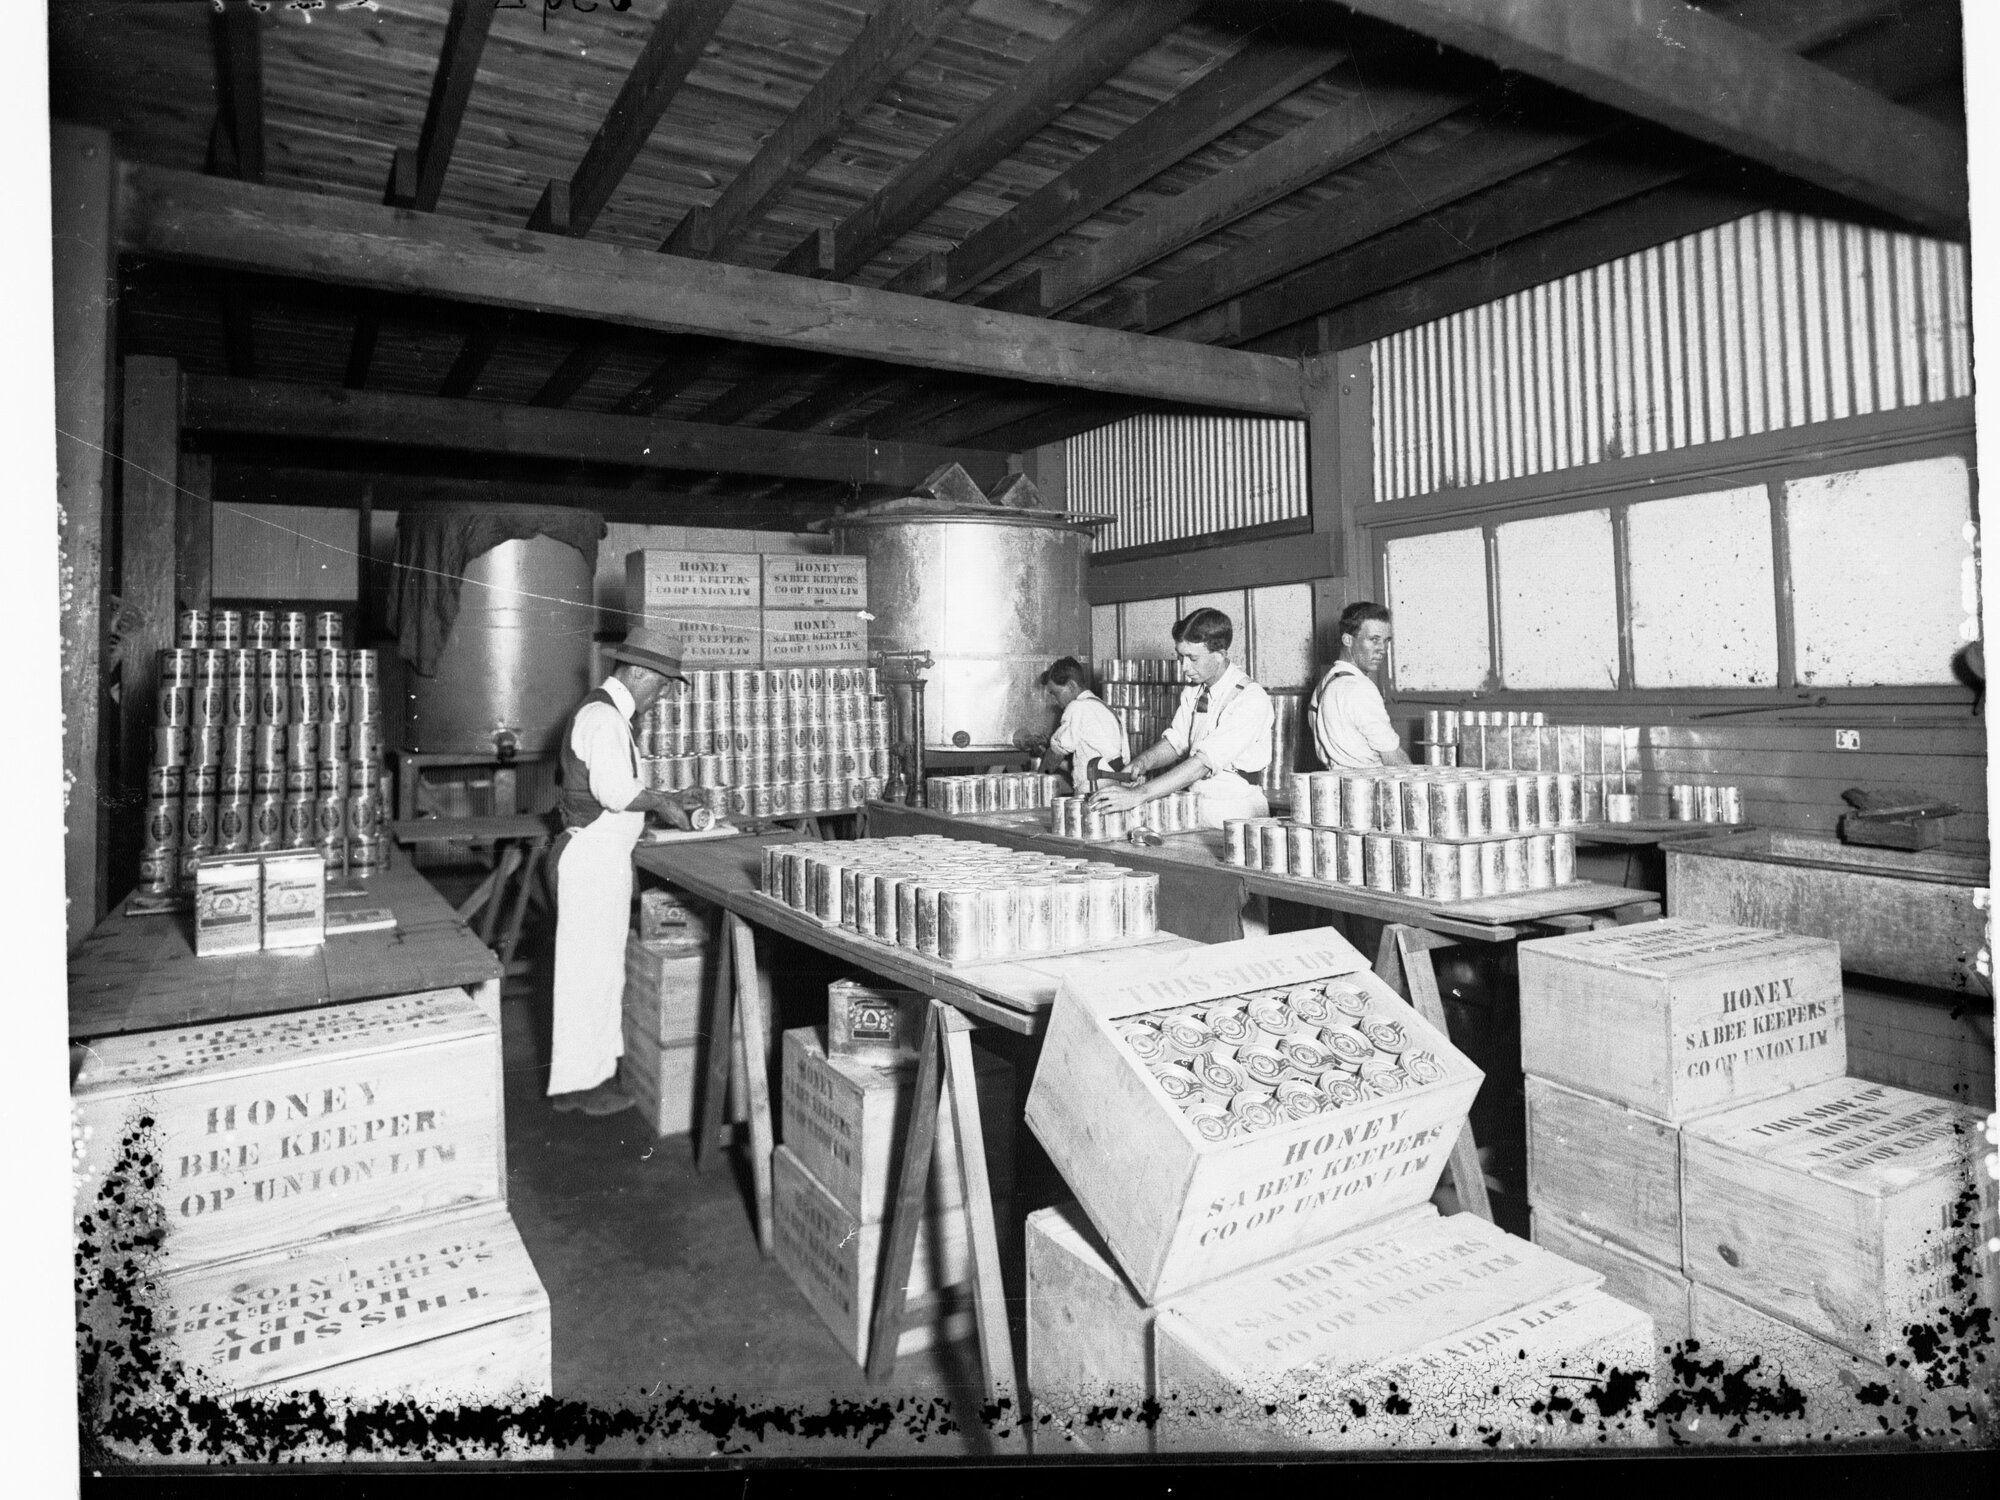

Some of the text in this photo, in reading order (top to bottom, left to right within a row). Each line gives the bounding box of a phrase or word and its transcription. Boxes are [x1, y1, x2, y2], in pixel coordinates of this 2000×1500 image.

[680, 561, 727, 572] HONEY
[700, 575, 750, 584] KEEPERS
[796, 562, 839, 572] HONEY
[813, 575, 858, 584] KEEPERS
[693, 587, 726, 595] UNION
[790, 586, 804, 594] OP
[807, 587, 838, 595] UNION
[680, 622, 727, 632] HONEY
[699, 635, 750, 644] KEEPERS
[794, 620, 838, 631] HONEY
[813, 631, 858, 641] KEEPERS
[692, 647, 726, 656] UNION
[790, 645, 804, 654] OP
[807, 643, 838, 652] UNION
[1118, 950, 1335, 1004] THIS SIDE UP
[1722, 977, 1795, 1014] HONEY
[1753, 1001, 1827, 1034] KEEPERS
[1688, 1060, 1711, 1079] CO
[1716, 1053, 1738, 1073] OP
[1744, 1037, 1795, 1065] UNION
[205, 1081, 378, 1136] HONEY
[1745, 1088, 1887, 1137] THIS SIDE UP
[1806, 1106, 1892, 1138] HONEY
[1869, 1106, 1950, 1137] KEEPERS
[1283, 1109, 1409, 1168] HONEY
[179, 1143, 260, 1179] BEE
[1255, 1168, 1314, 1202] BEE
[1321, 1125, 1444, 1181] KEEPERS
[1841, 1158, 1875, 1170] CO
[1868, 1146, 1901, 1160] OP
[180, 1187, 236, 1219] OP
[253, 1157, 375, 1202] UNION
[1200, 1221, 1238, 1247] CO
[1246, 1204, 1285, 1230] OP
[1295, 1172, 1378, 1213] UNION
[1273, 1239, 1404, 1291] HONEY
[1354, 1239, 1490, 1290] KEEPERS
[232, 1268, 358, 1305] UNION
[1265, 1253, 1523, 1352] CO OP UNION LIM
[211, 1287, 489, 1366] THIS SIDE
[215, 1286, 412, 1346] HONEY
